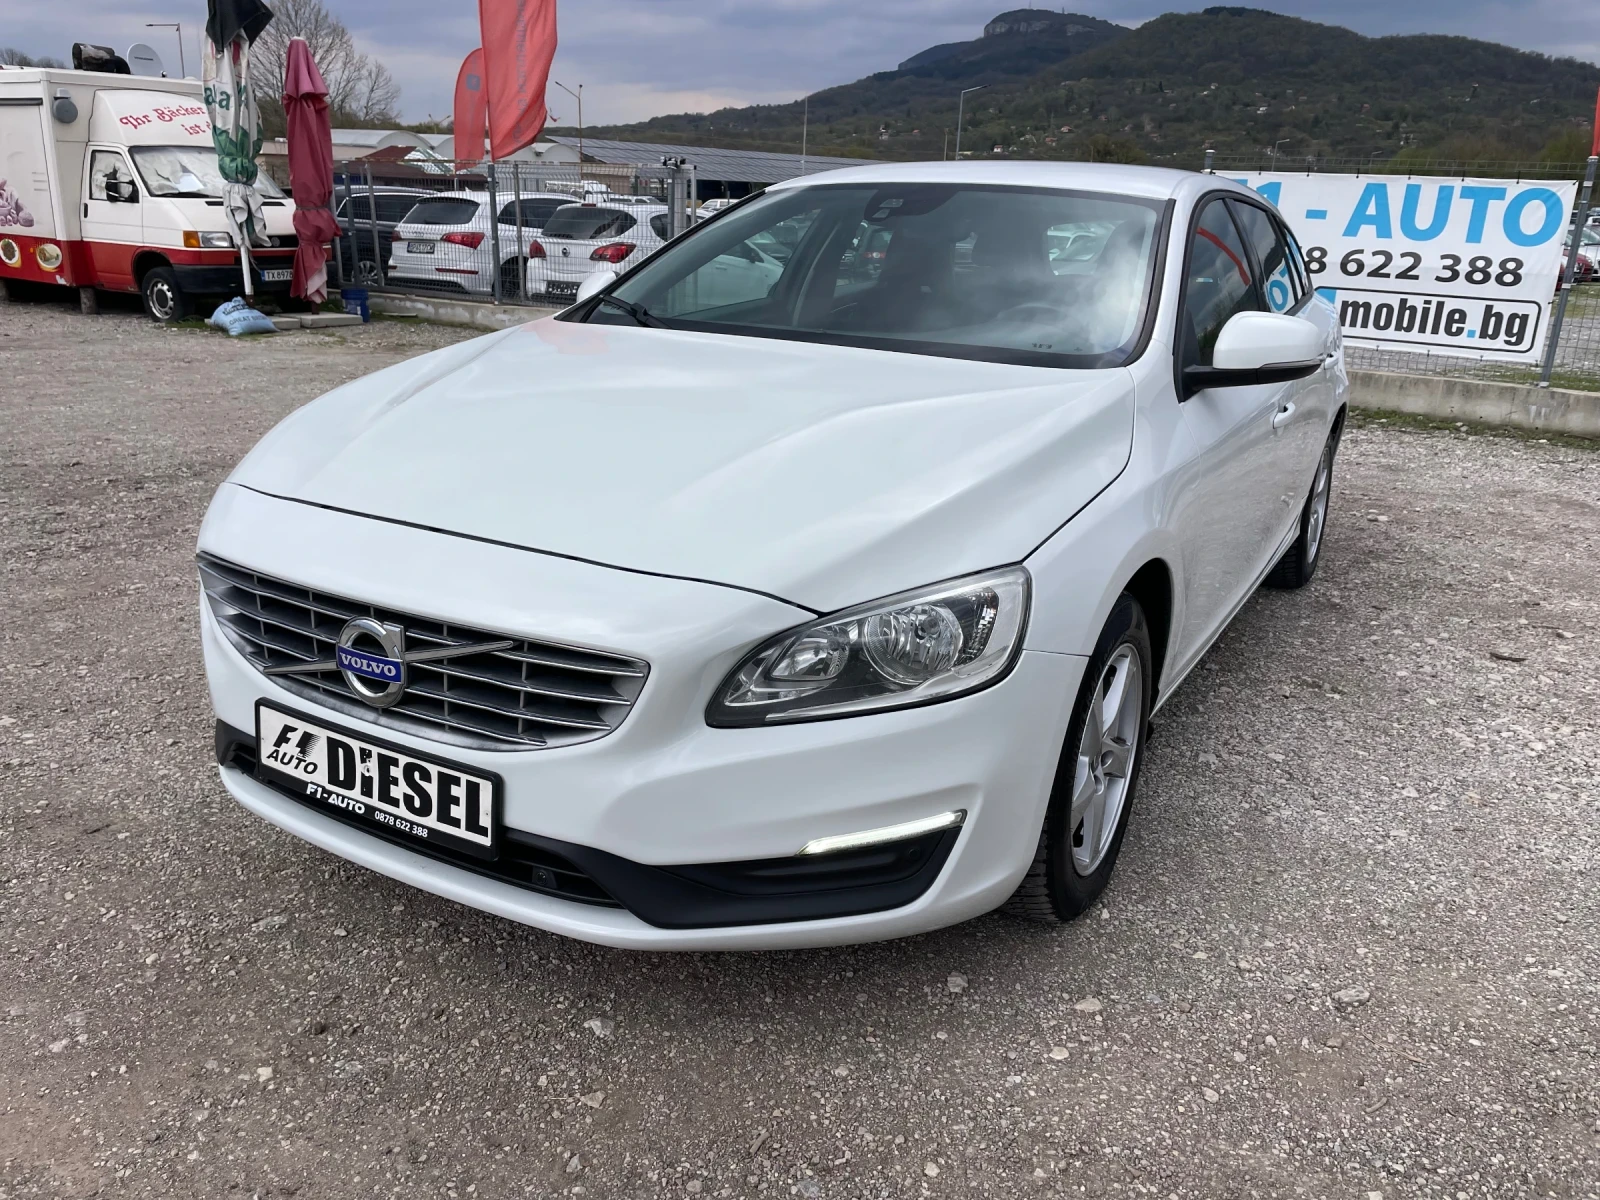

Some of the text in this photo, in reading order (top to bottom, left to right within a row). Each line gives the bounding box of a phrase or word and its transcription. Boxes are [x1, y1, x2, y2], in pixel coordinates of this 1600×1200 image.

[153, 105, 206, 122] Bäcker
[181, 123, 206, 135] ist
[1342, 182, 1564, 247] AUTO
[1300, 246, 1524, 287] 8 622 388
[1339, 298, 1530, 347] mobile.bg
[340, 652, 397, 677] VOLVO
[273, 723, 321, 759] F1
[266, 748, 318, 775] AUTO
[306, 783, 366, 815] F1-AUTO
[374, 810, 429, 839] 0878 622 388
